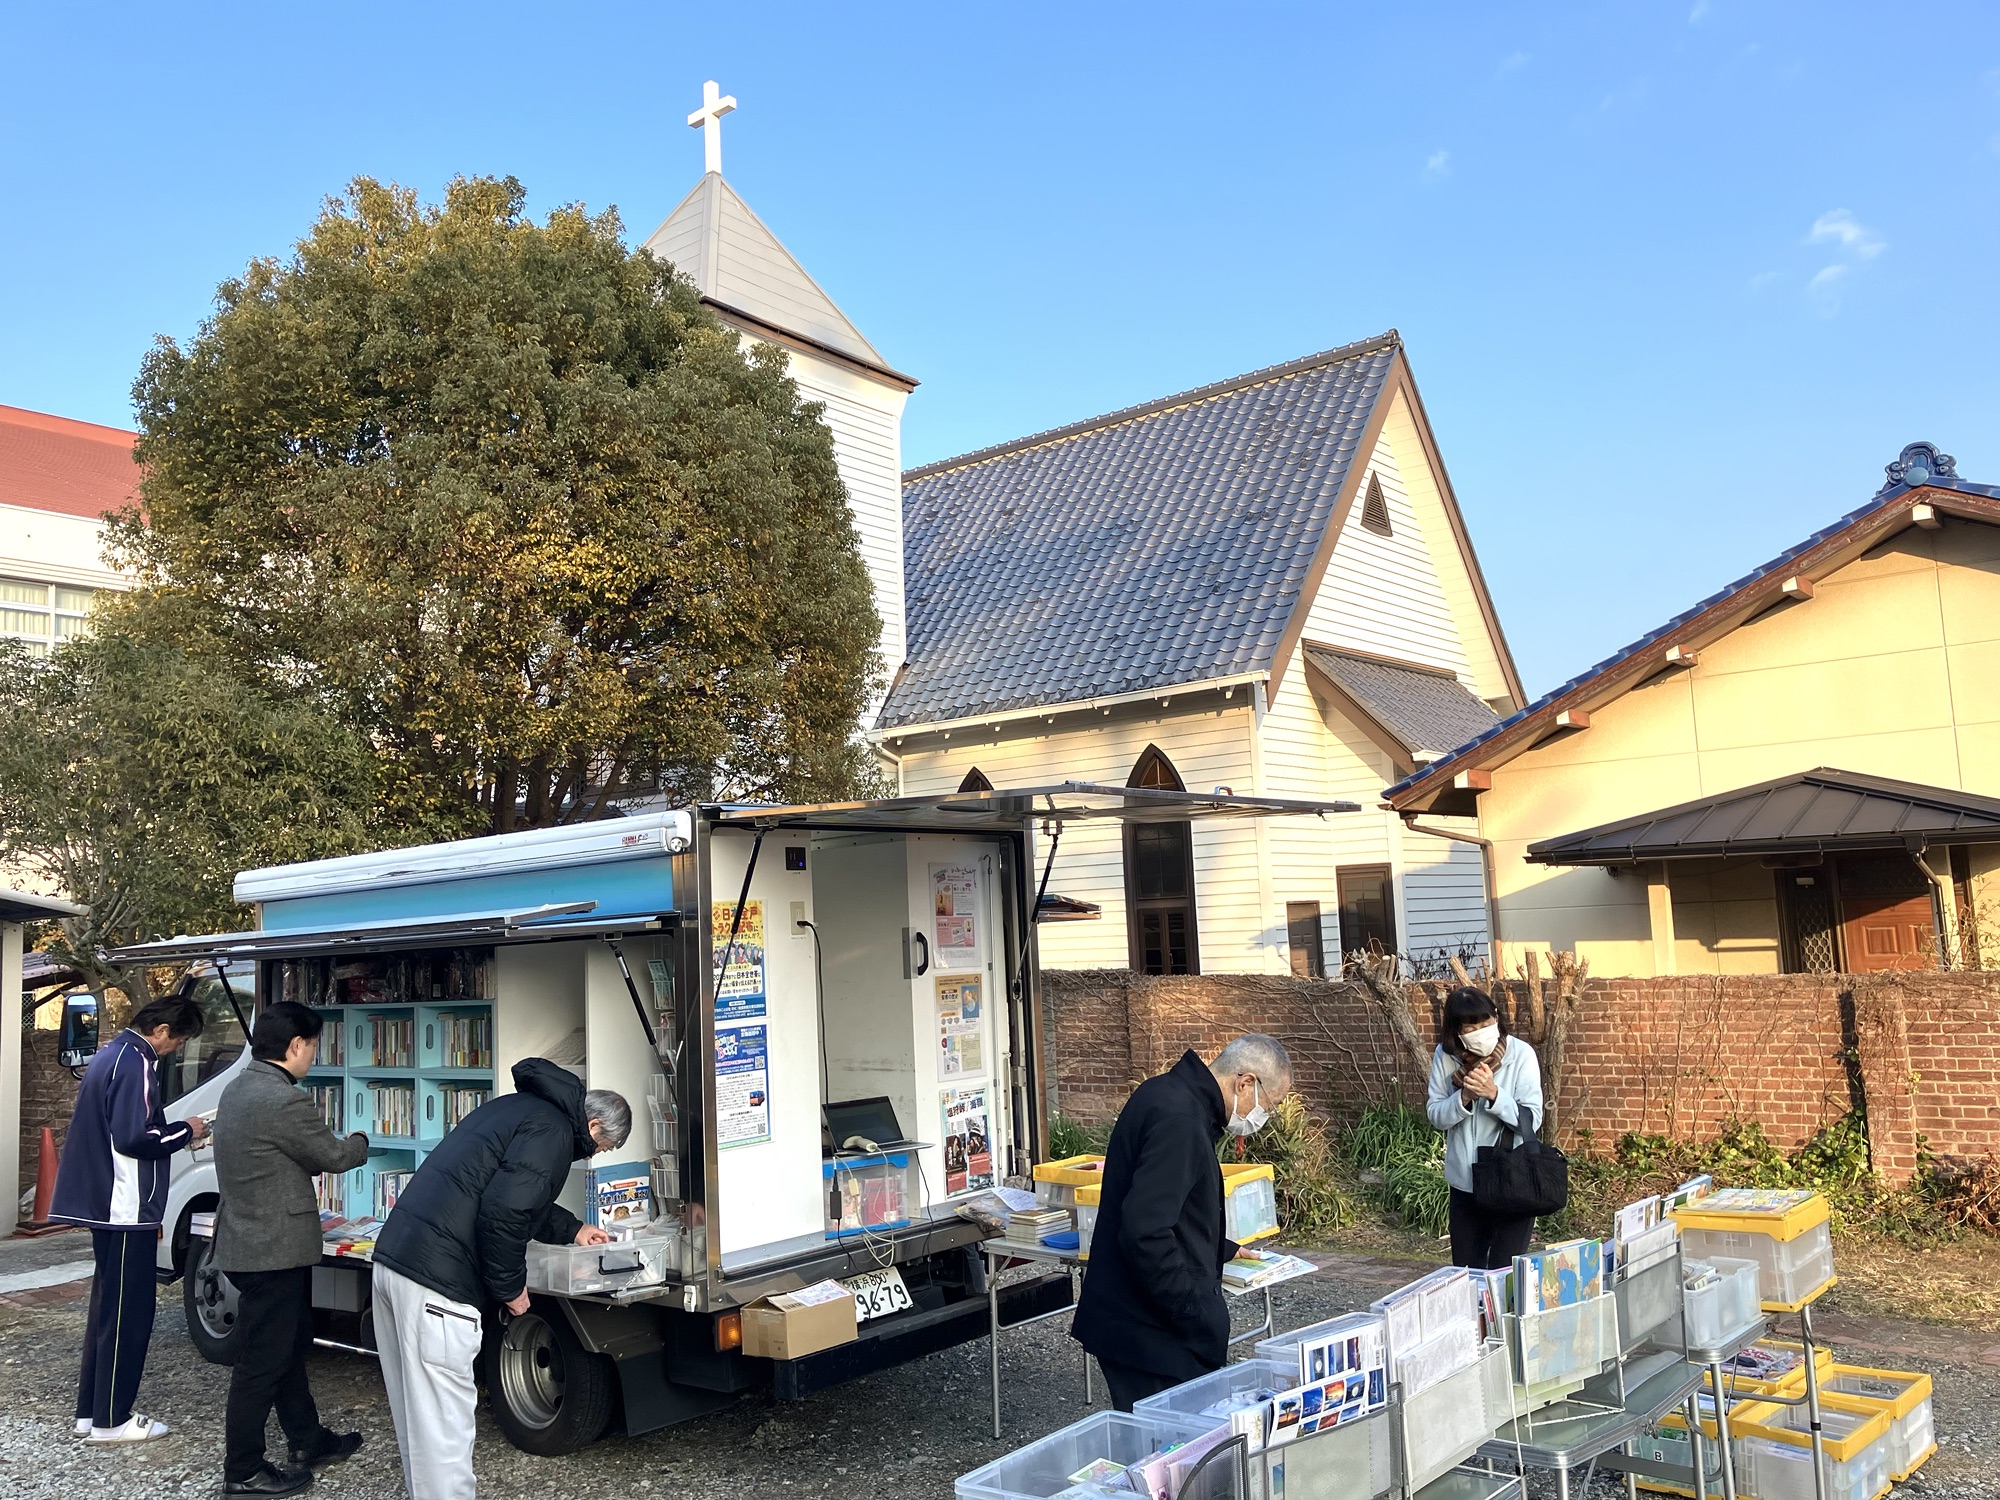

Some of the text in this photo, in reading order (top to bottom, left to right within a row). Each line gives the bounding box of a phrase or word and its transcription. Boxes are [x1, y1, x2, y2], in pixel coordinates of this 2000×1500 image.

[712, 921, 759, 934] トラク配布に
[856, 1284, 907, 1315] 96-79
[1654, 1451, 1662, 1461] B
